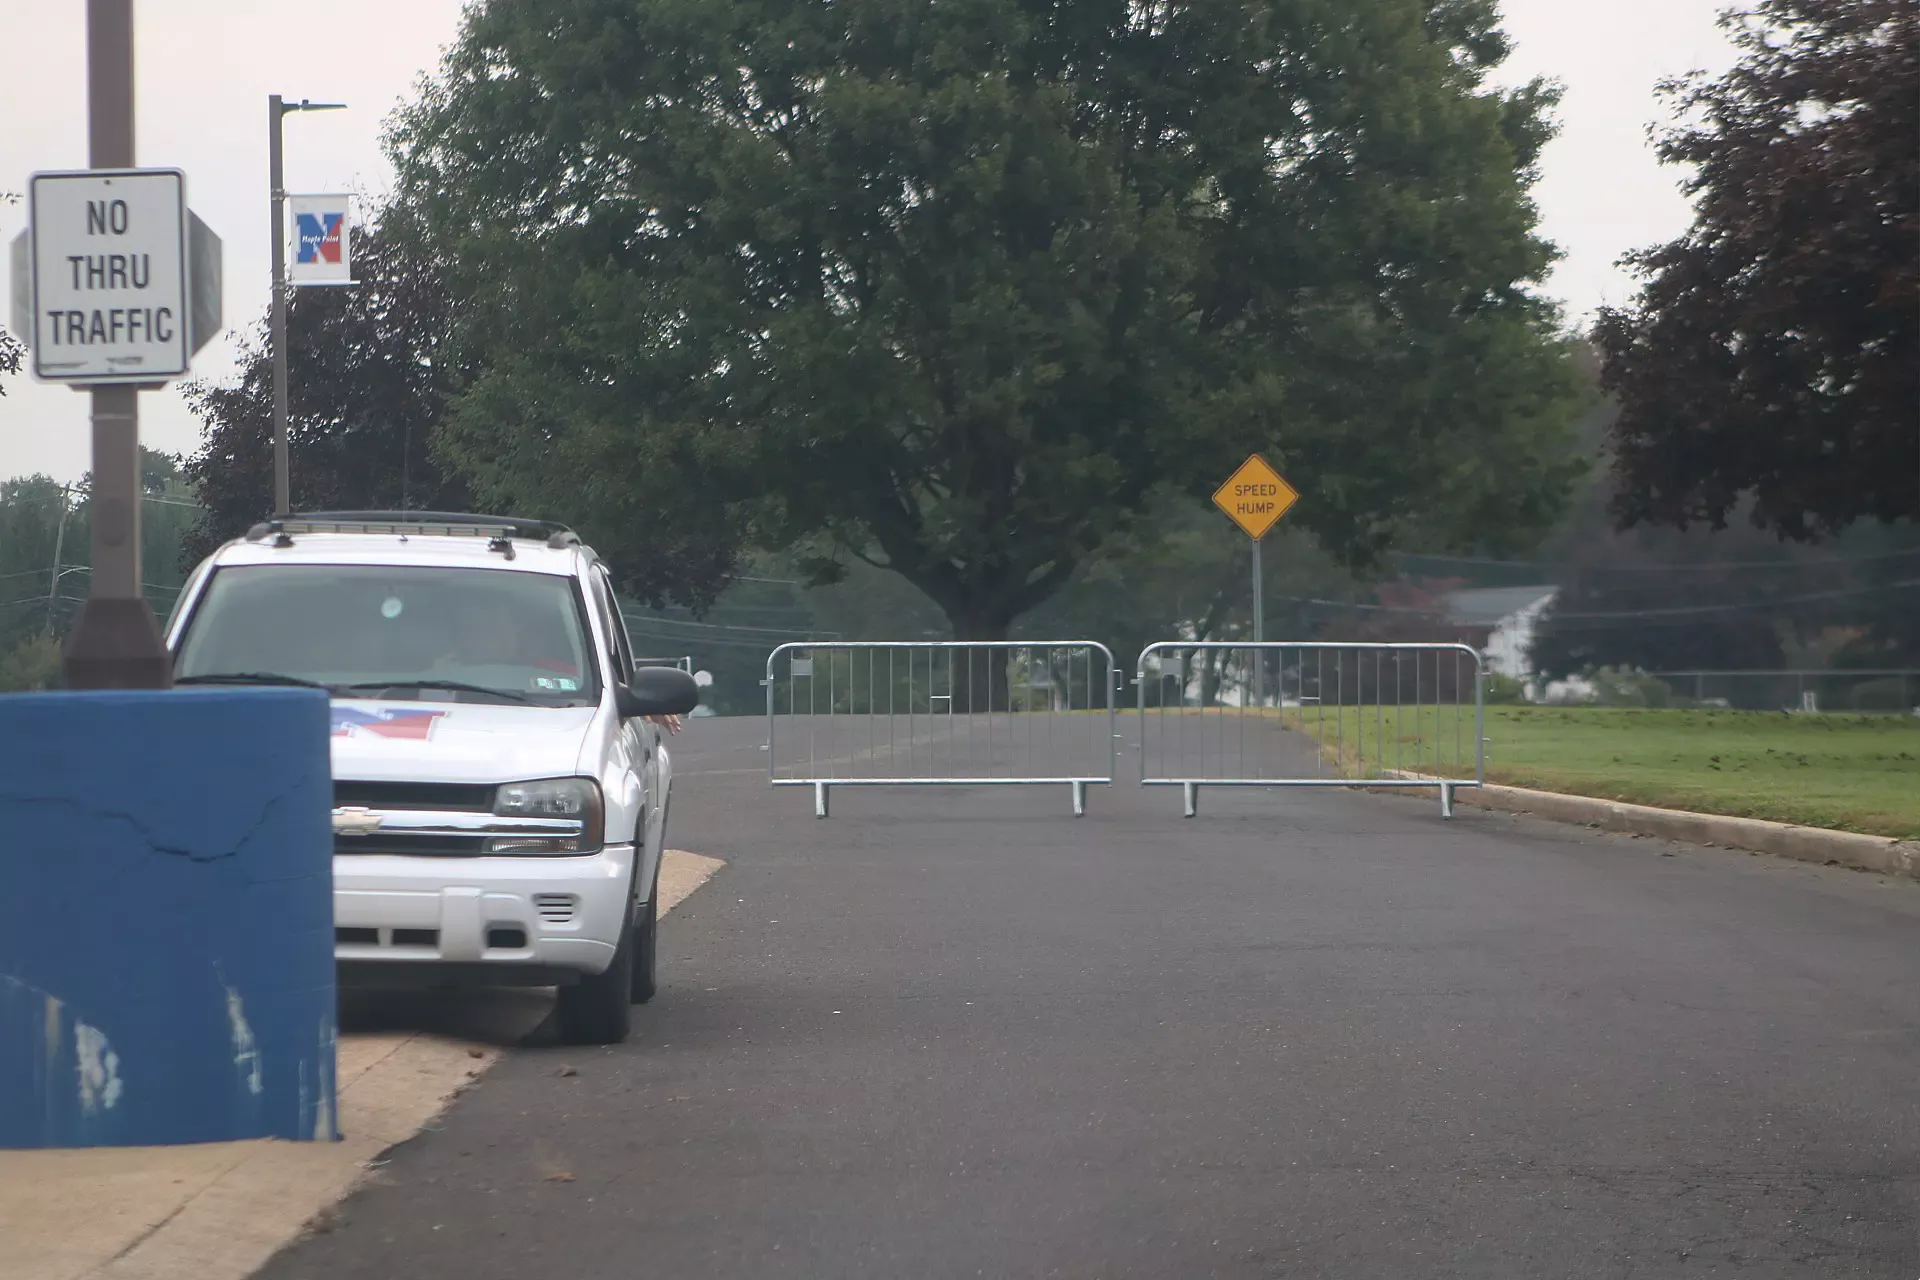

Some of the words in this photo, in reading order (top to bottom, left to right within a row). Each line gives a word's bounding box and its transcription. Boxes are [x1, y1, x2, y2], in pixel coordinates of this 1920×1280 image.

[87, 199, 129, 236] NO
[295, 212, 344, 264] N
[66, 253, 150, 290] THRU
[47, 307, 174, 345] TRAFFIC
[1234, 484, 1277, 497] SPEED
[1236, 502, 1275, 515] HUMP
